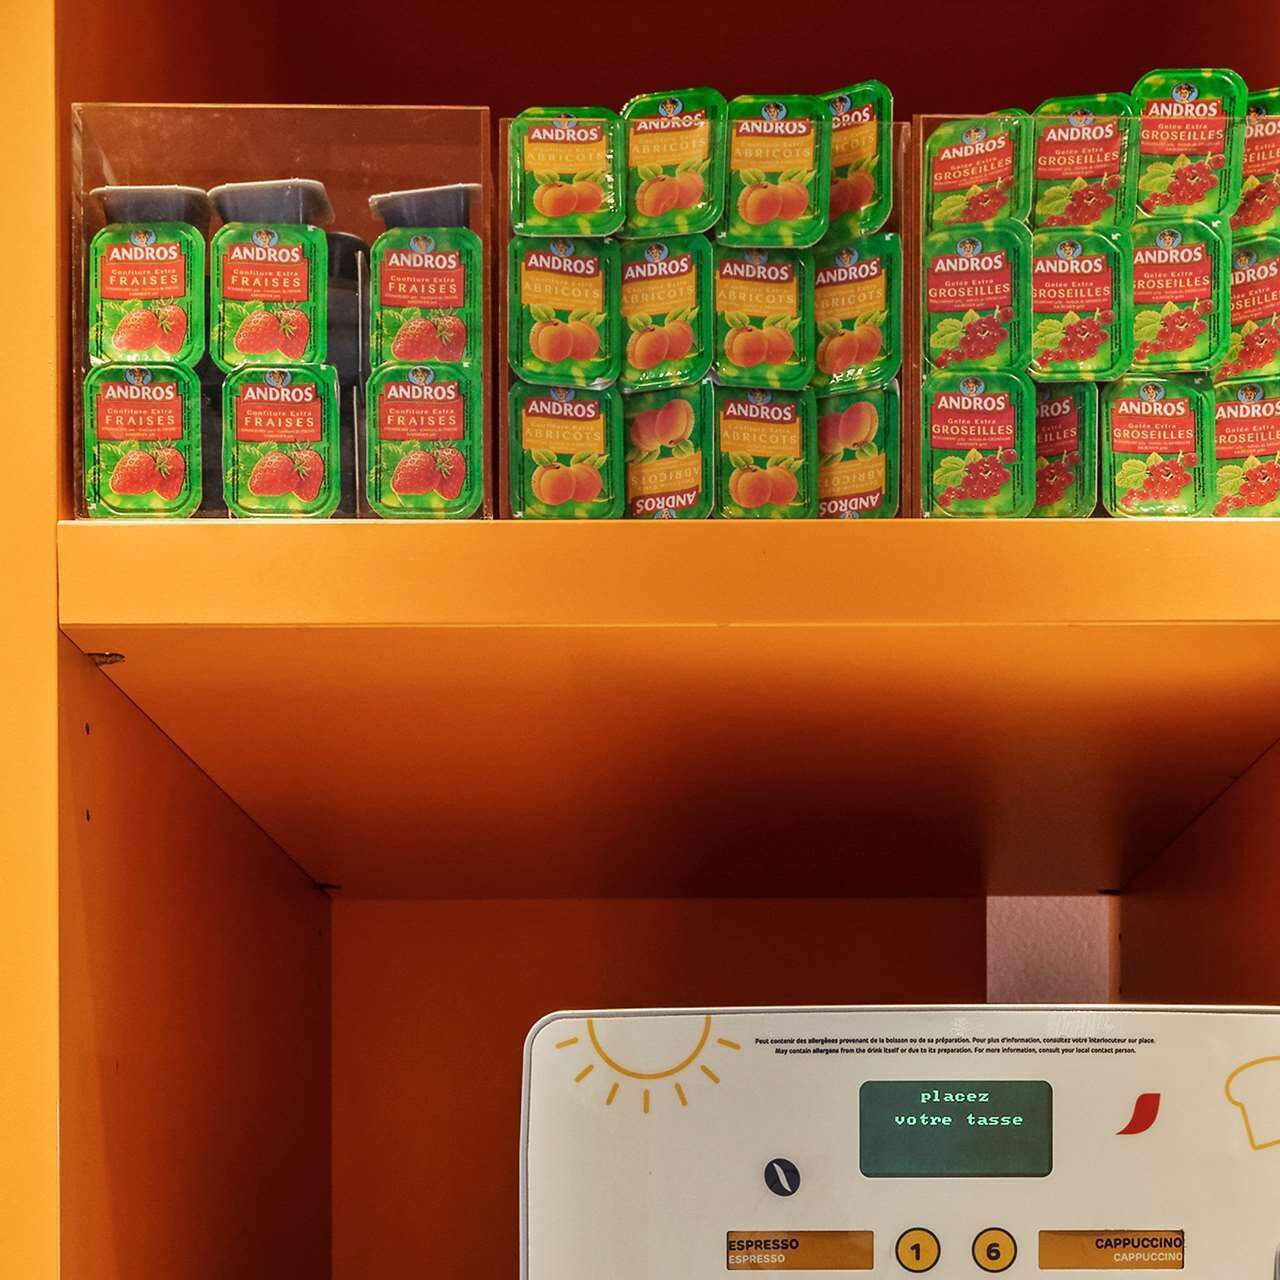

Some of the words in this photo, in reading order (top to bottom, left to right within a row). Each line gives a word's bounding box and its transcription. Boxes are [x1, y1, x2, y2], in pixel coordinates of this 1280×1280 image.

[1148, 101, 1218, 118] ANDROS
[636, 112, 704, 131] ANDROS
[739, 120, 807, 134] ANDROS
[531, 127, 598, 141] ANDROS
[1046, 124, 1114, 142] ANDROS
[1141, 128, 1223, 141] GROSEILLES
[940, 135, 1005, 161] ANDROS
[1038, 150, 1120, 166] GROSEILLES
[934, 155, 1012, 181] GROSEILLES
[109, 246, 178, 263] ANDROS
[231, 246, 300, 263] ANDROS
[388, 252, 457, 270] ANDROS
[1134, 246, 1202, 265] ANDROS
[528, 253, 595, 274] ANDROS
[624, 258, 689, 280] ANDROS
[722, 262, 790, 280] ANDROS
[934, 255, 1003, 273] ANDROS
[1035, 255, 1103, 274] ANDROS
[109, 273, 178, 287] FRAISES
[231, 274, 301, 288] FRAISES
[815, 262, 878, 285] ANDROS
[388, 281, 457, 295] FRAISES
[928, 282, 1010, 298] GROSEILLES
[104, 384, 174, 401] ANDROS
[244, 385, 313, 402] ANDROS
[387, 384, 456, 401] ANDROS
[528, 400, 595, 417] ANDROS
[727, 402, 792, 421] ANDROS
[938, 395, 1005, 412] ANDROS
[1118, 400, 1185, 417] ANDROS
[105, 413, 175, 426] FRAISES
[244, 414, 315, 428] FRAISES
[387, 414, 456, 426] FRAISES
[932, 423, 1013, 436] GROSEILLES
[1113, 427, 1194, 441] GROSEILLES
[635, 490, 697, 513] ANDROS
[820, 493, 881, 516] ANDROS
[921, 1089, 989, 1102] placez
[895, 1113, 952, 1126] votre
[966, 1113, 1024, 1126] tasse
[729, 1239, 799, 1250] ESPRESSO
[1095, 1237, 1183, 1249] CAPPUCCINO
[729, 1254, 785, 1264] ESPRESSO
[910, 1243, 922, 1261] 1
[985, 1243, 1001, 1261] 6
[1114, 1253, 1183, 1262] CAPPUCCINO
